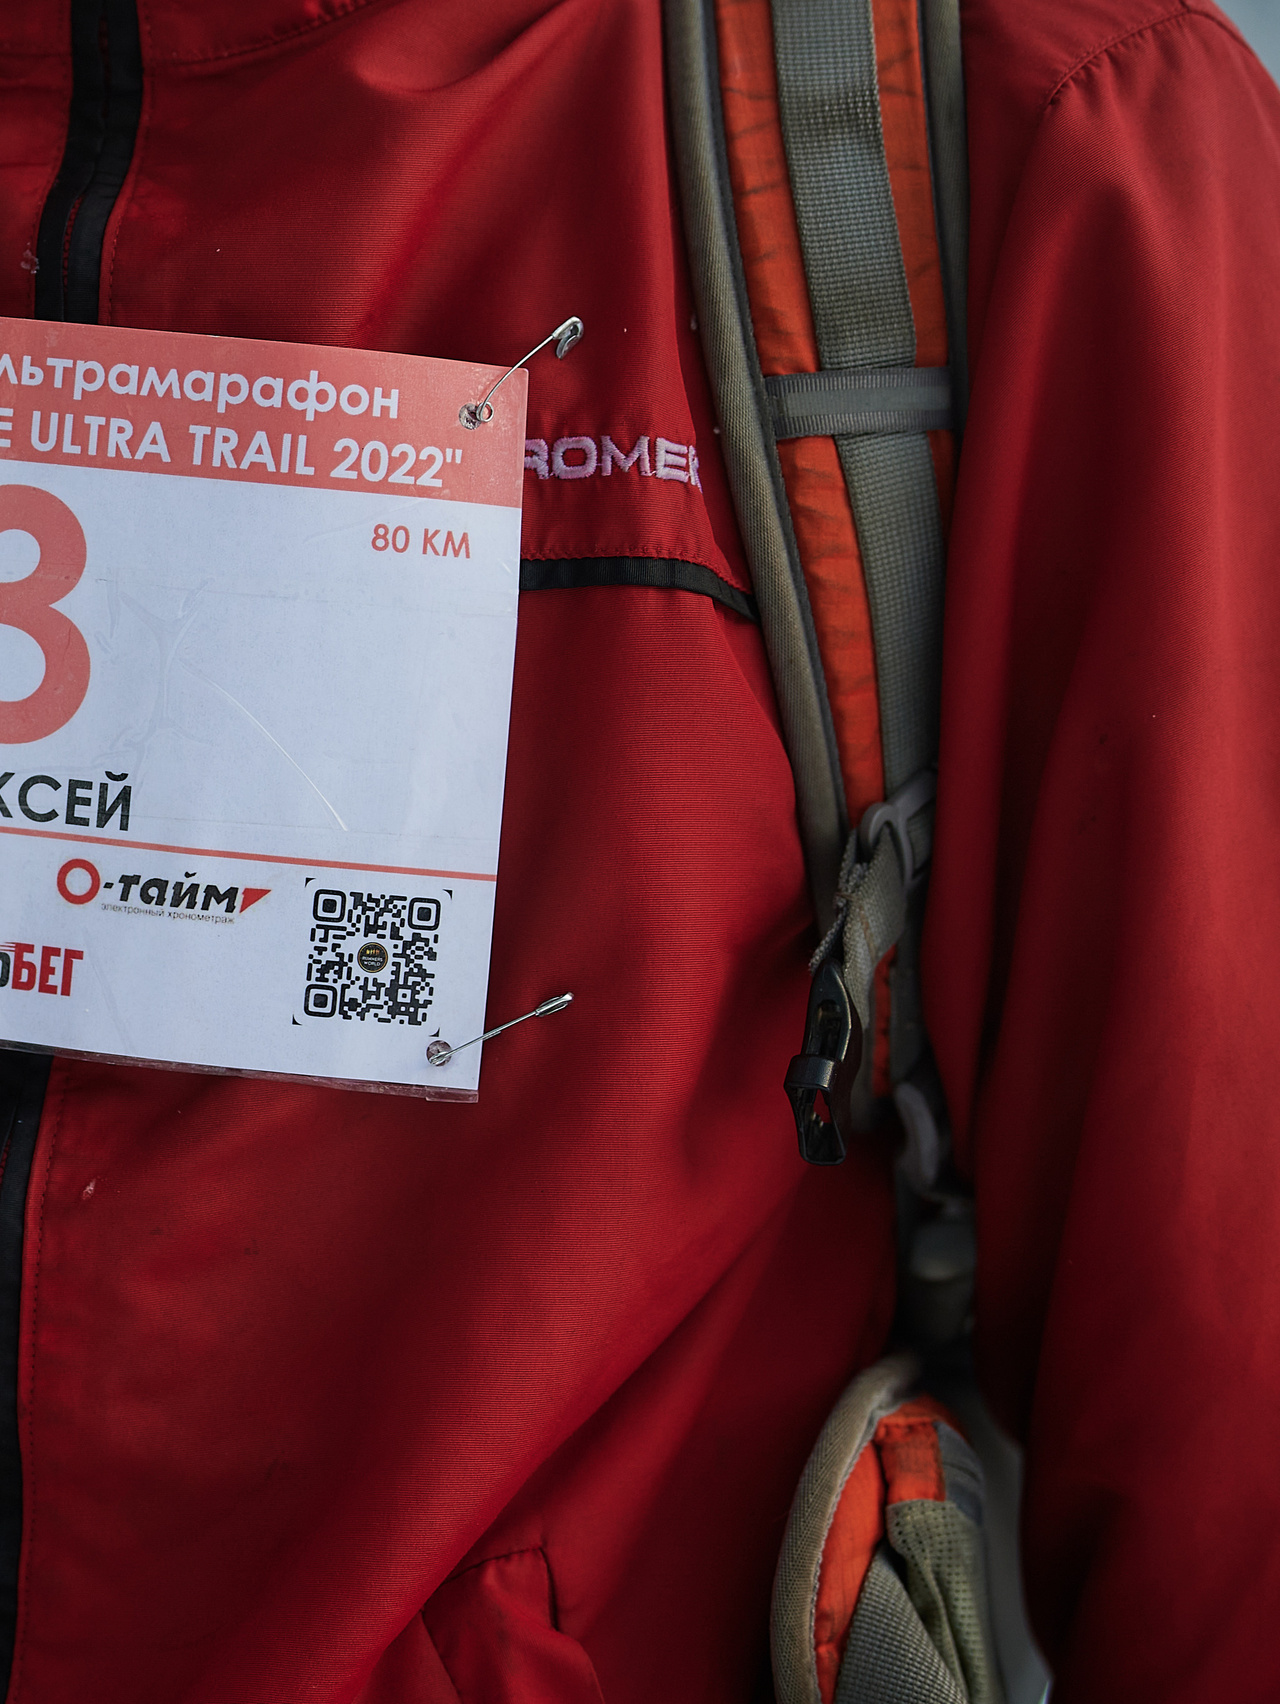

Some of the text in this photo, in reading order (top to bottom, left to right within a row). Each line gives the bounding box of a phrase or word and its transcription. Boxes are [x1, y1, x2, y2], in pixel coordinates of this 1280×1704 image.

[30, 411, 171, 462] ULTRA
[189, 425, 315, 475] TRAIL
[330, 438, 463, 487] 2022"
[371, 523, 410, 553] 80
[100, 902, 235, 924] электронный хронометраж
